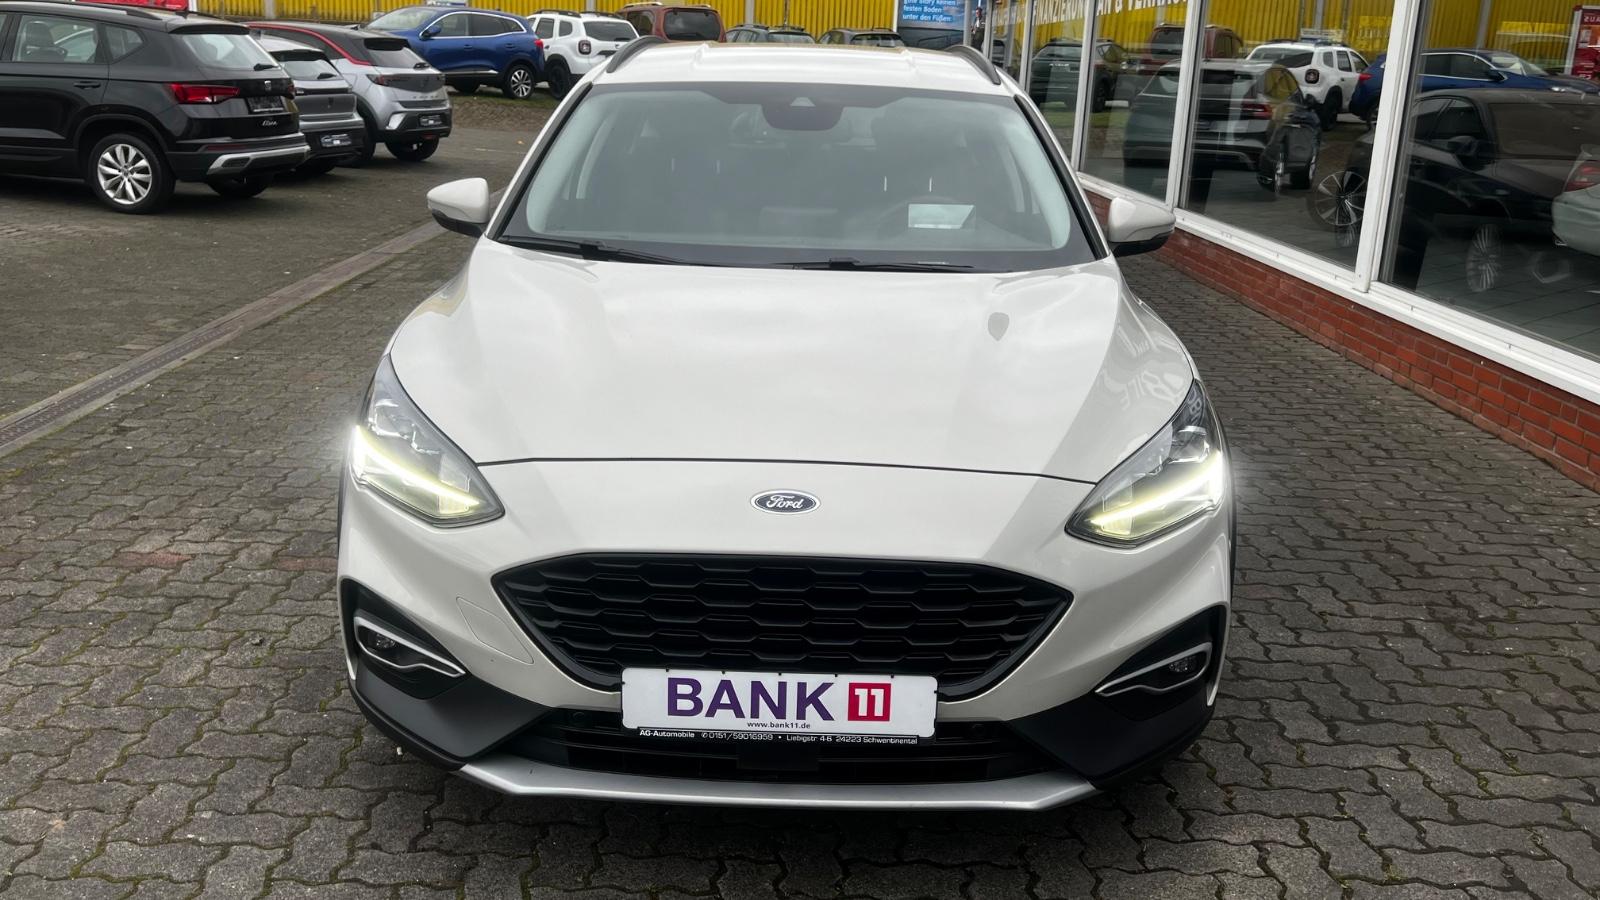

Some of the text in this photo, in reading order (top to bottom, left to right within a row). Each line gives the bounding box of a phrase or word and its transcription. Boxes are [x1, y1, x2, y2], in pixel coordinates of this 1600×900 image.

[1032, 0, 1086, 27] FINANZIERUN
[766, 494, 804, 509] Ford
[667, 676, 887, 722] BANK 11
[747, 721, 811, 729] www.bank11.de
[639, 729, 695, 738] AG-Automobile
